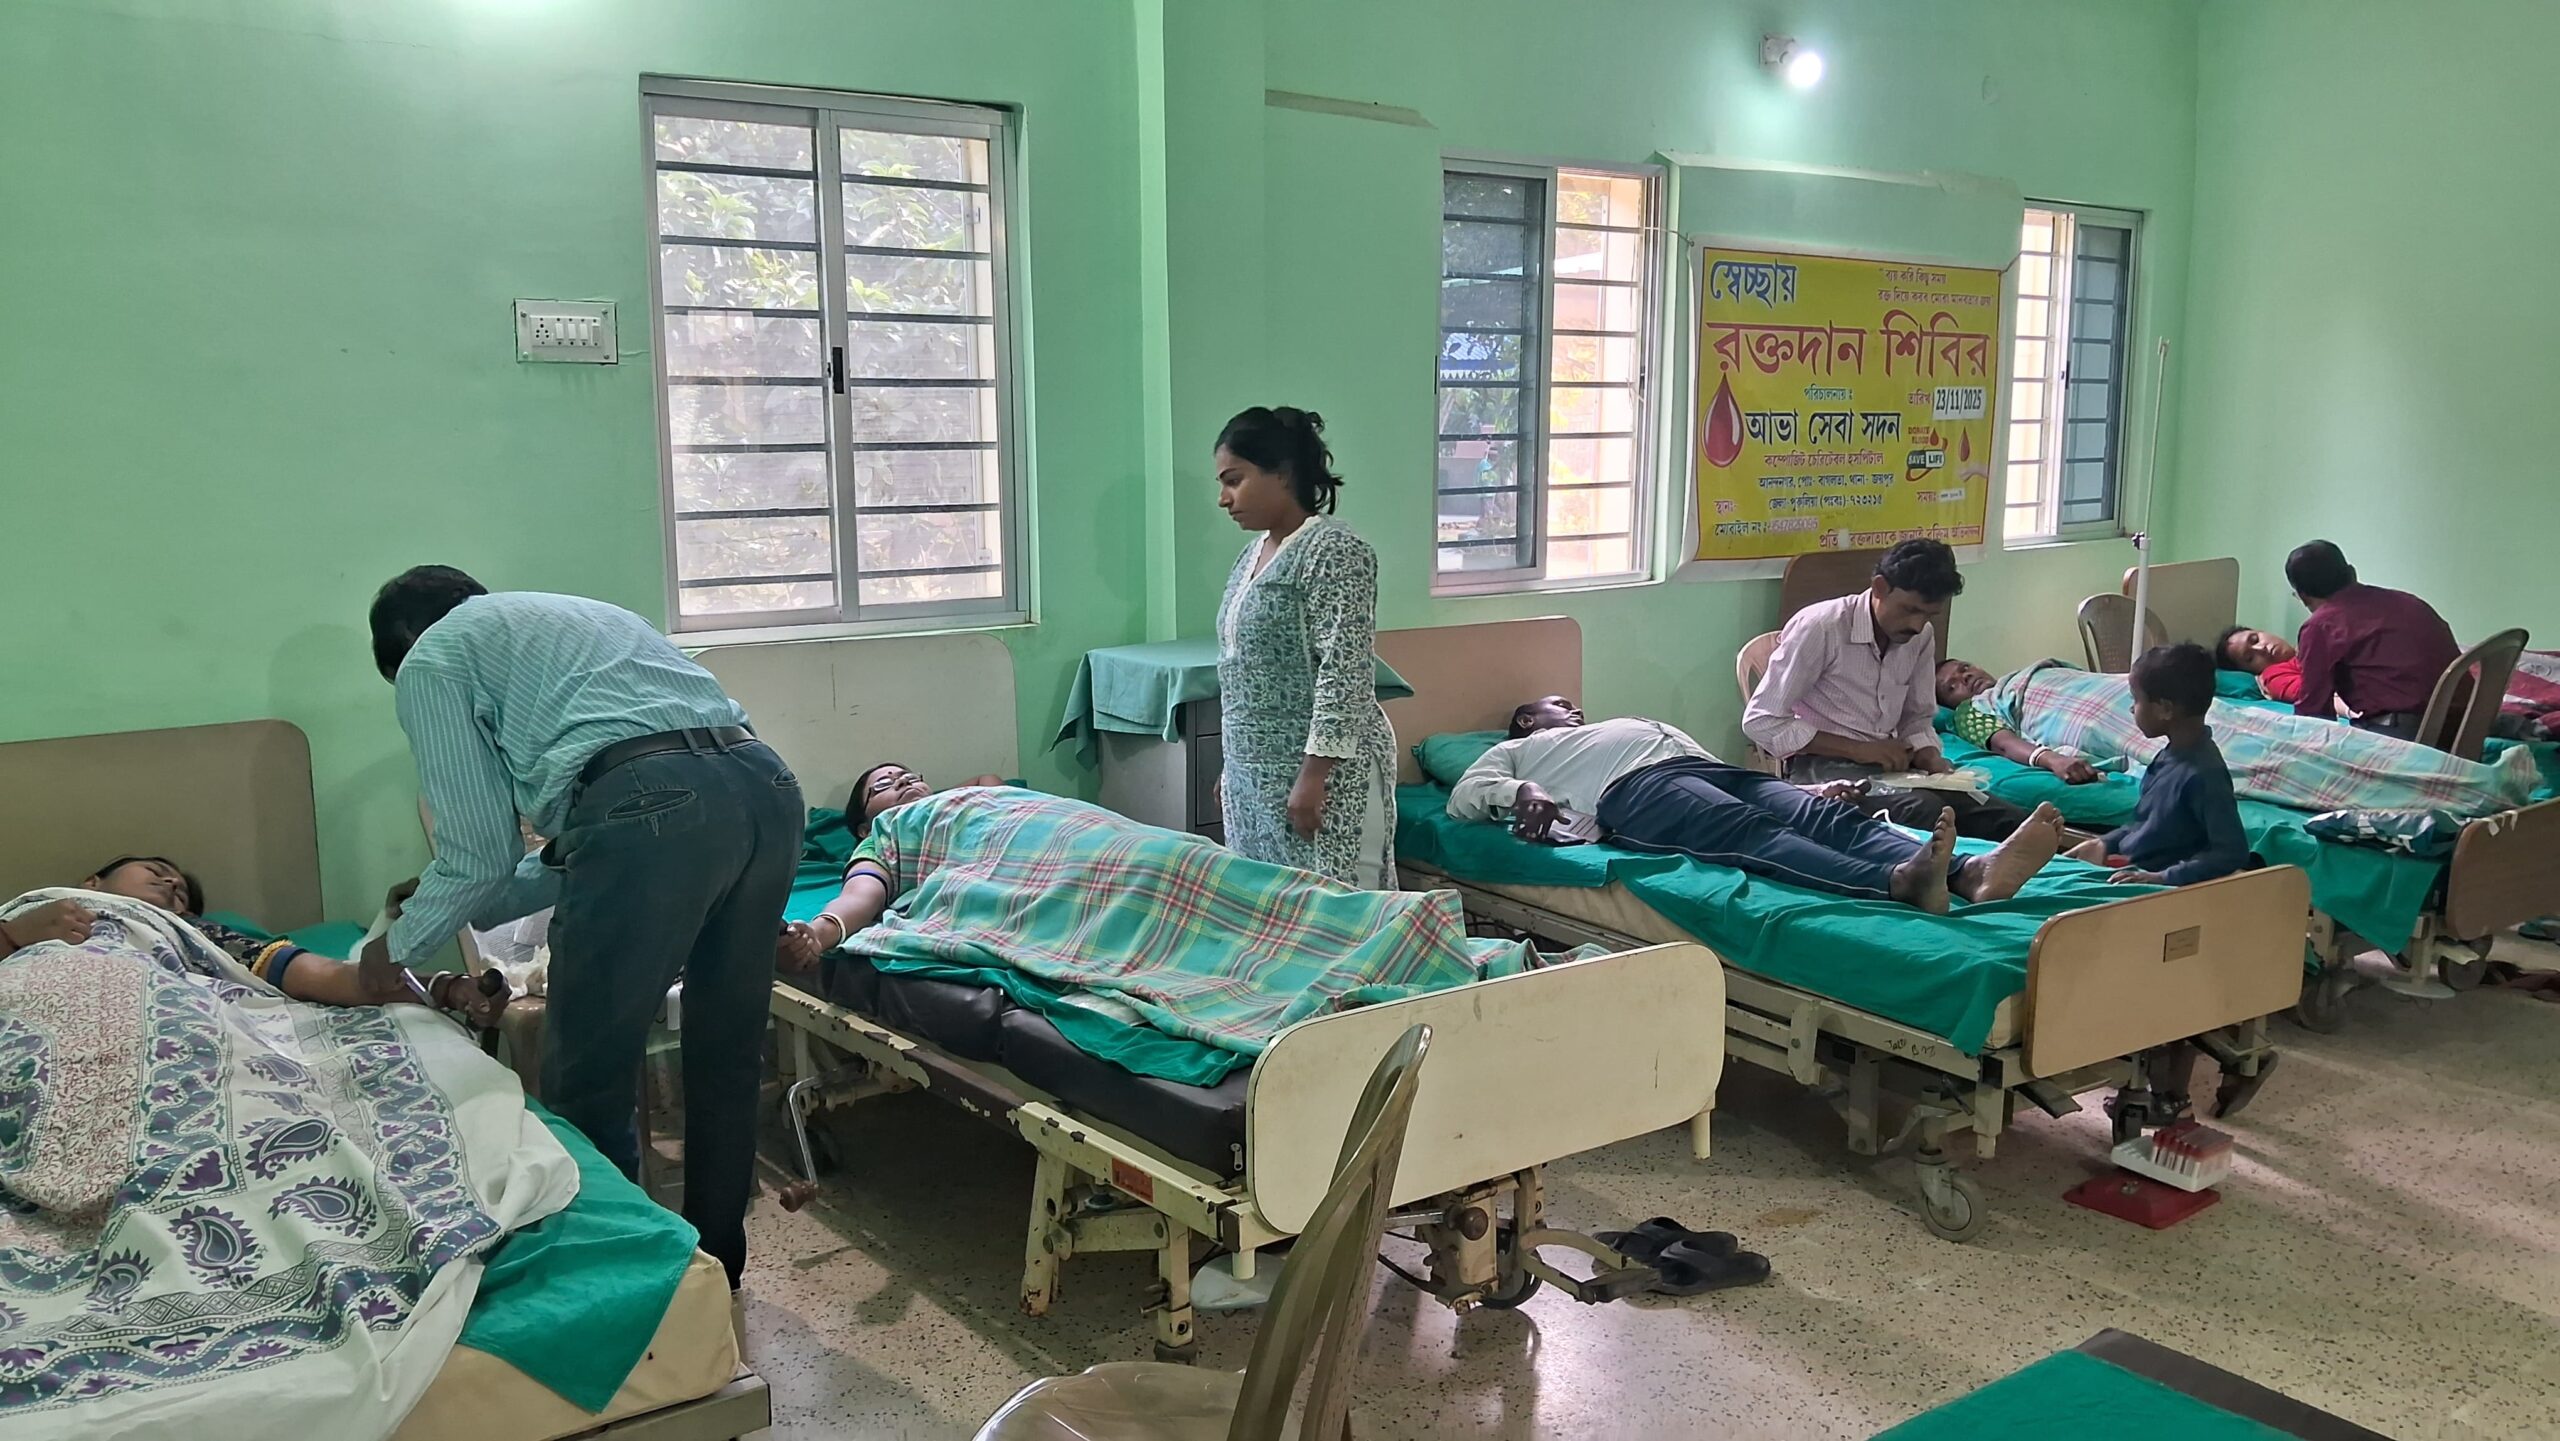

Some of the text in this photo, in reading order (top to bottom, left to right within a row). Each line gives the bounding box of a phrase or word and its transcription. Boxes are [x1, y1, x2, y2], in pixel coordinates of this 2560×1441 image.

[1711, 259, 1797, 308] স্বেচ্ছায়
[1706, 309, 1990, 378] রক্তদান শিবির
[1936, 388, 1982, 414] 23/11/2025
[1745, 408, 1901, 445] আভা সেবা সদন
[1908, 454, 1942, 465] SAVE LIFE
